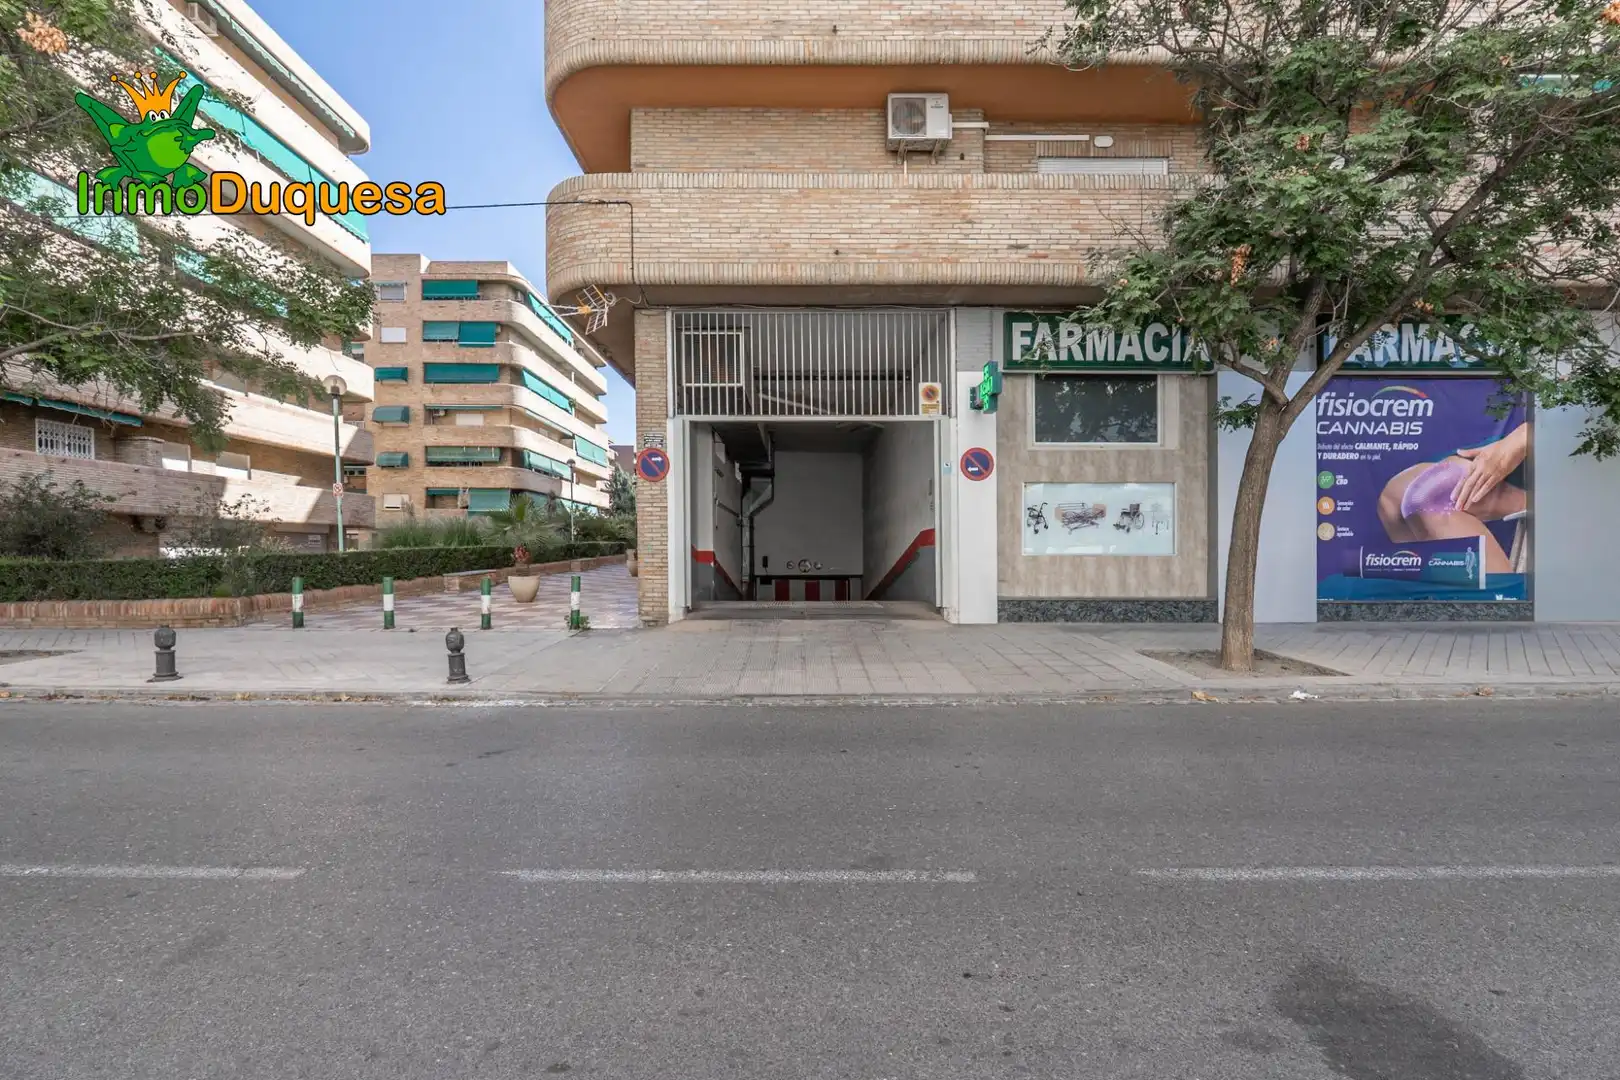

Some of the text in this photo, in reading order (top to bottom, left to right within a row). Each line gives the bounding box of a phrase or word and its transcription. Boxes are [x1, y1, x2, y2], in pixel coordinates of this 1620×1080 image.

[1011, 322, 1211, 362] FARMACIA
[1317, 392, 1434, 417] fisiocrem
[1317, 421, 1424, 436] CANNABIS
[1322, 452, 1360, 460] DURADERO
[1365, 553, 1422, 566] fisiocrem
